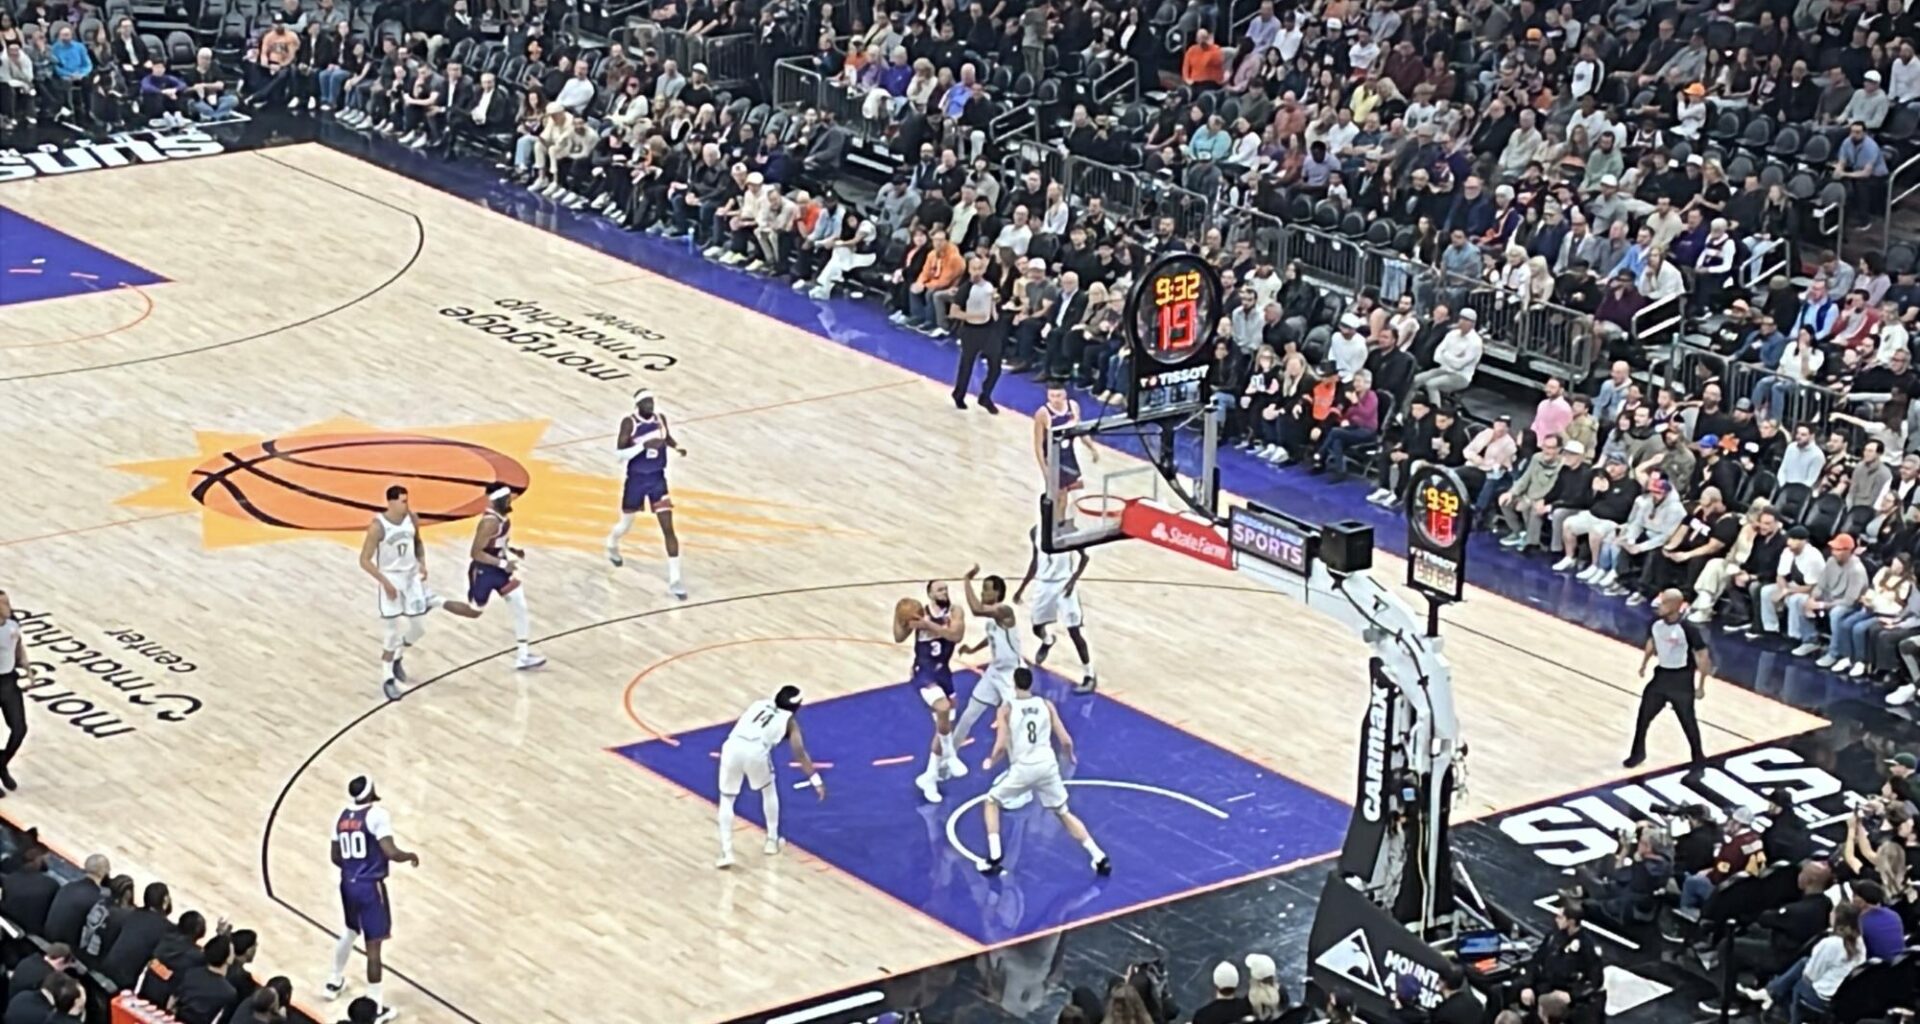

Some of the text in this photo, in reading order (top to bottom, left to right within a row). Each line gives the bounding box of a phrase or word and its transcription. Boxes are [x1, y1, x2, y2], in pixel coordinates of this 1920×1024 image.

[1155, 272, 1201, 305] 9:32
[1162, 301, 1196, 350] 19
[439, 306, 631, 381] mortgage
[1158, 364, 1210, 386] TISSOT
[1232, 523, 1303, 565] SPORTS
[104, 629, 197, 673] center
[930, 640, 942, 656] 3
[752, 710, 775, 728] 14
[1027, 721, 1037, 744] 8
[340, 831, 367, 859] 00
